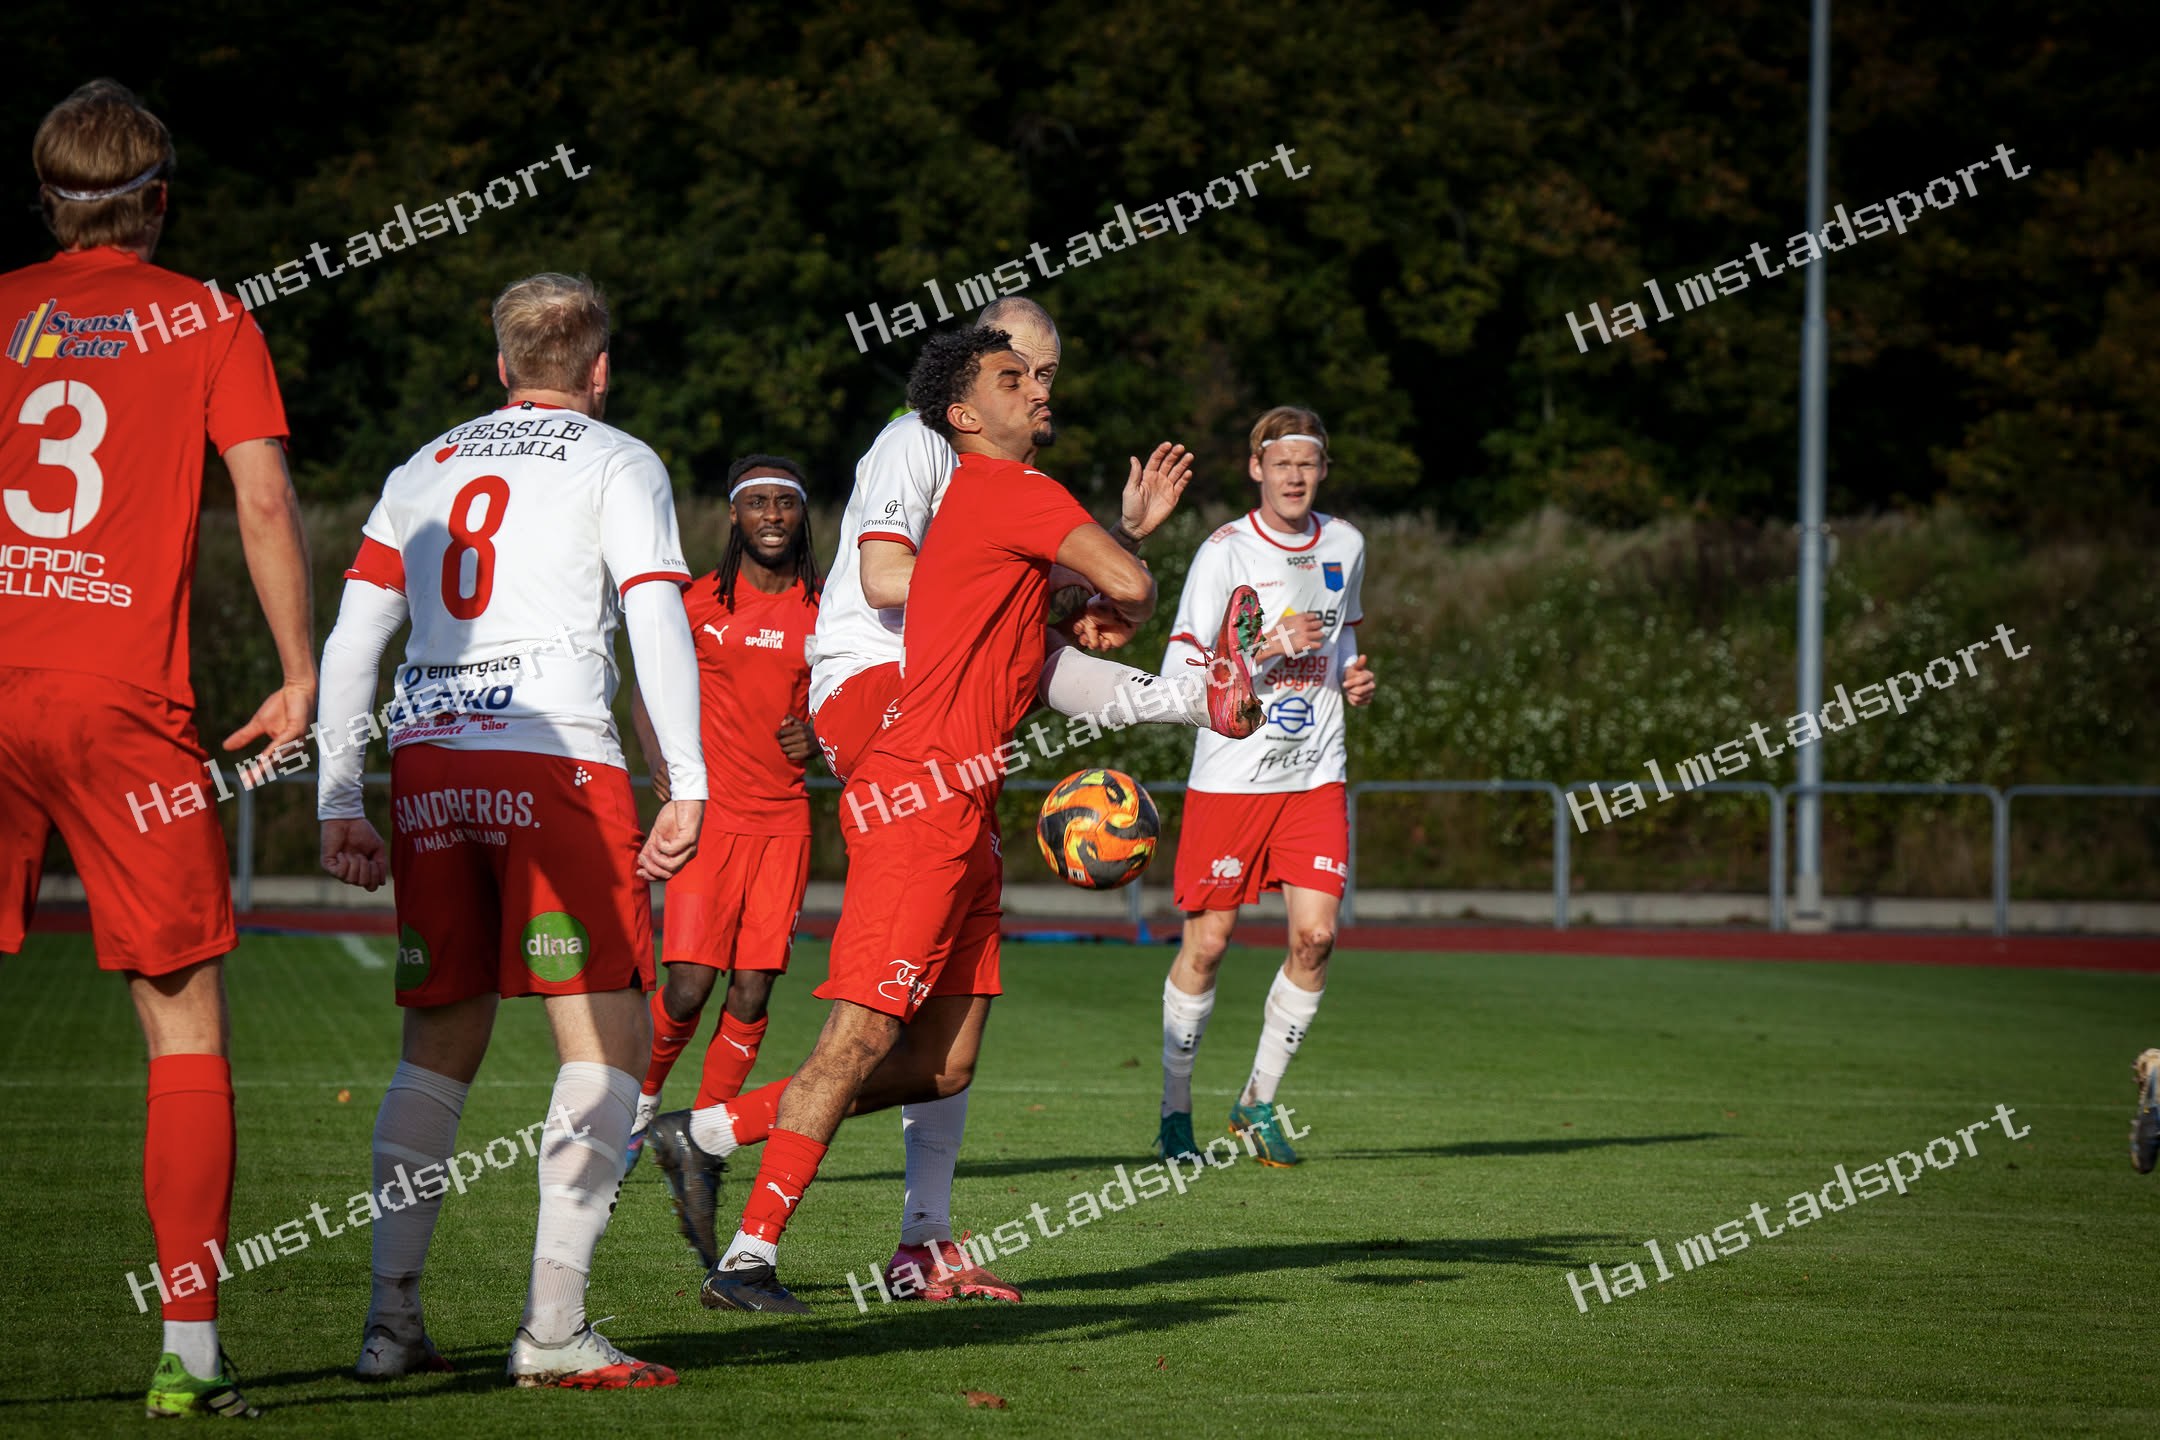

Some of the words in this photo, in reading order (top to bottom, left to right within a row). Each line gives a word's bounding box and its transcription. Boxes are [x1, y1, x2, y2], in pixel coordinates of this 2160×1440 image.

[56, 336, 127, 358] Cater
[446, 419, 588, 445] GESSLE
[3, 379, 108, 539] 3
[456, 440, 567, 462] HALMIA
[440, 474, 511, 621] 8
[745, 636, 783, 650] SPORTIA
[759, 628, 784, 640] TEAM
[526, 933, 584, 956] dina
